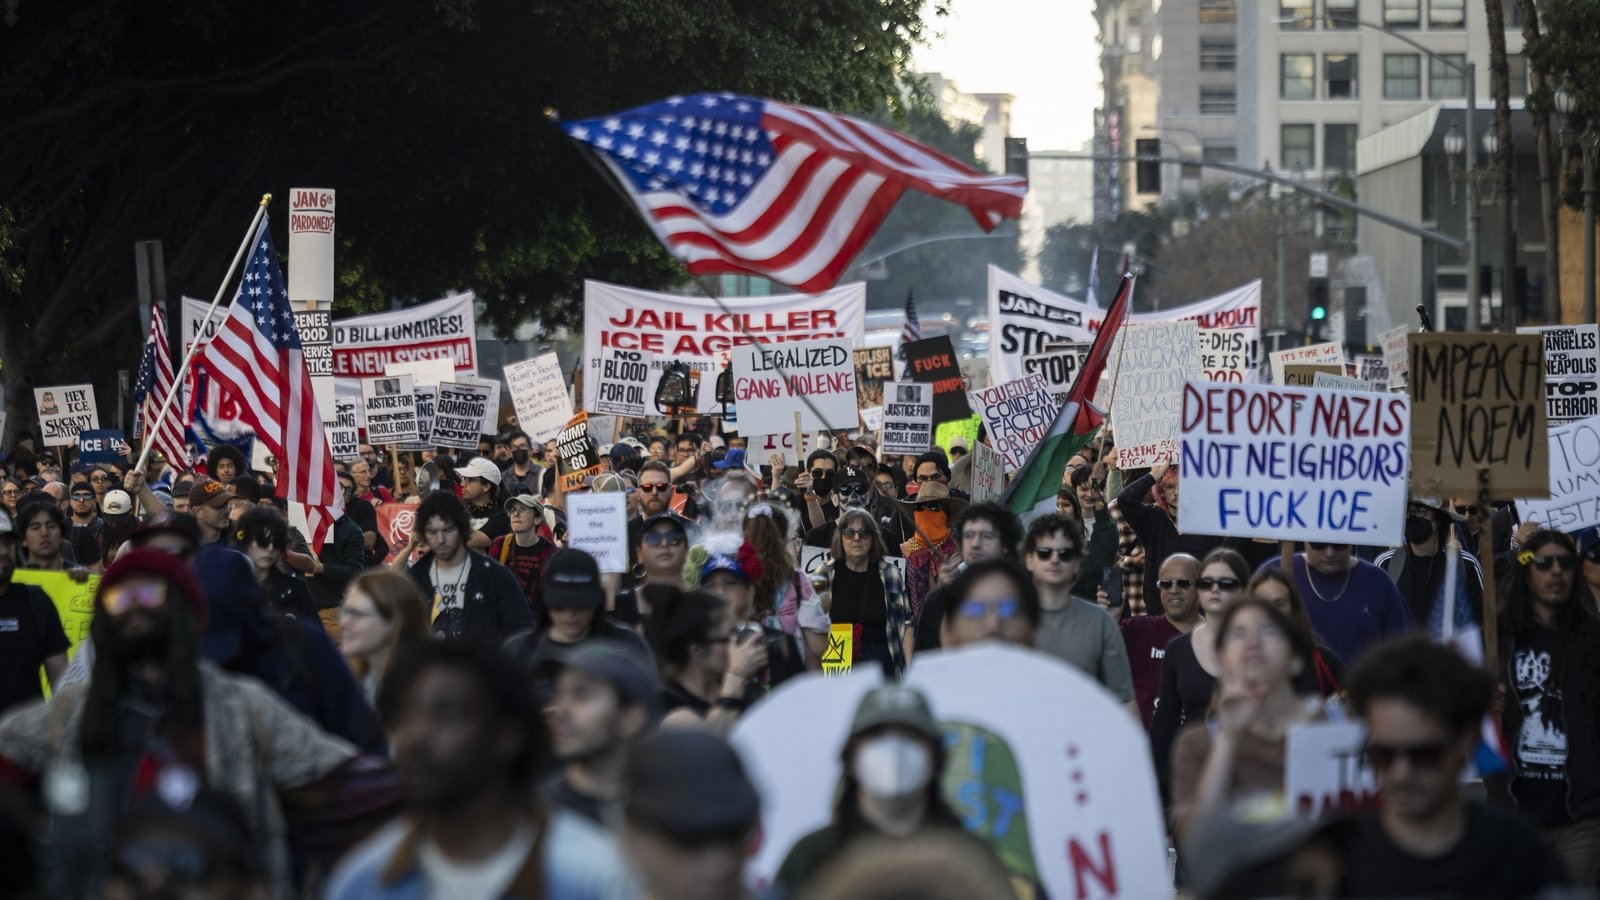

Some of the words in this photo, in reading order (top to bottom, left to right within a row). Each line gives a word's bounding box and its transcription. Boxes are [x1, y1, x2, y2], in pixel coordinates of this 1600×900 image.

[293, 192, 319, 209] JAN
[291, 213, 335, 231] PARDONED?
[1000, 294, 1046, 318] JAN
[609, 308, 697, 331] JAIL
[705, 309, 837, 332] KILLER
[334, 327, 346, 344] O
[349, 315, 465, 342] BILLIONAIRES!
[601, 331, 664, 354] ICE
[1546, 333, 1596, 350] ANGELES
[614, 351, 642, 361] NO
[752, 346, 848, 371] LEGALIZED
[853, 349, 889, 364] BOLISH
[1299, 350, 1319, 360] TIME
[1322, 346, 1337, 354] WE
[866, 362, 890, 378] ICE
[913, 354, 952, 373] FUCK
[1025, 354, 1076, 385] STOP
[1222, 355, 1240, 369] IS
[604, 359, 648, 383] BLOOD
[1414, 341, 1543, 405] IMPEACH
[736, 375, 781, 401] GANG
[783, 371, 855, 397] VIOLENCE
[978, 384, 1006, 406] YOU
[1005, 374, 1049, 399] EITHER
[1317, 378, 1343, 390] NORTH
[1546, 382, 1598, 396] TOP
[64, 389, 87, 403] HEY
[441, 391, 487, 402] STOP
[600, 382, 625, 402] FOR
[626, 386, 646, 405] OIL
[366, 397, 397, 410] JUSTICE
[398, 395, 413, 407] FOR
[437, 400, 486, 417] BOMBING
[885, 403, 916, 417] JUSTICE
[916, 404, 931, 417] FOR
[985, 387, 1054, 421] CONDEM
[1182, 382, 1306, 436] DEPORT
[1311, 392, 1407, 439] NAZIS
[1546, 397, 1598, 417] TERROR
[45, 415, 76, 434] SUCK
[77, 414, 93, 430] MY
[368, 412, 415, 423] RENEE
[434, 415, 481, 432] VENEZUELA
[988, 403, 1058, 440] FACISM
[368, 423, 395, 434] NICOLE
[396, 420, 416, 433] GOOD
[431, 428, 479, 441] NOW!
[885, 422, 930, 432] RENEE
[81, 440, 102, 452] ICE
[885, 432, 909, 444] NICOLE
[910, 432, 930, 445] GOOD
[997, 432, 1019, 453] OR
[1435, 404, 1535, 471] NOEM
[559, 437, 590, 460] MUST
[571, 454, 588, 471] GO
[1182, 440, 1242, 478] NOT
[847, 467, 855, 476] LA
[576, 504, 616, 516] Impeach
[1219, 488, 1308, 530] FUCK
[1317, 489, 1379, 532] ICE.
[589, 521, 604, 529] the
